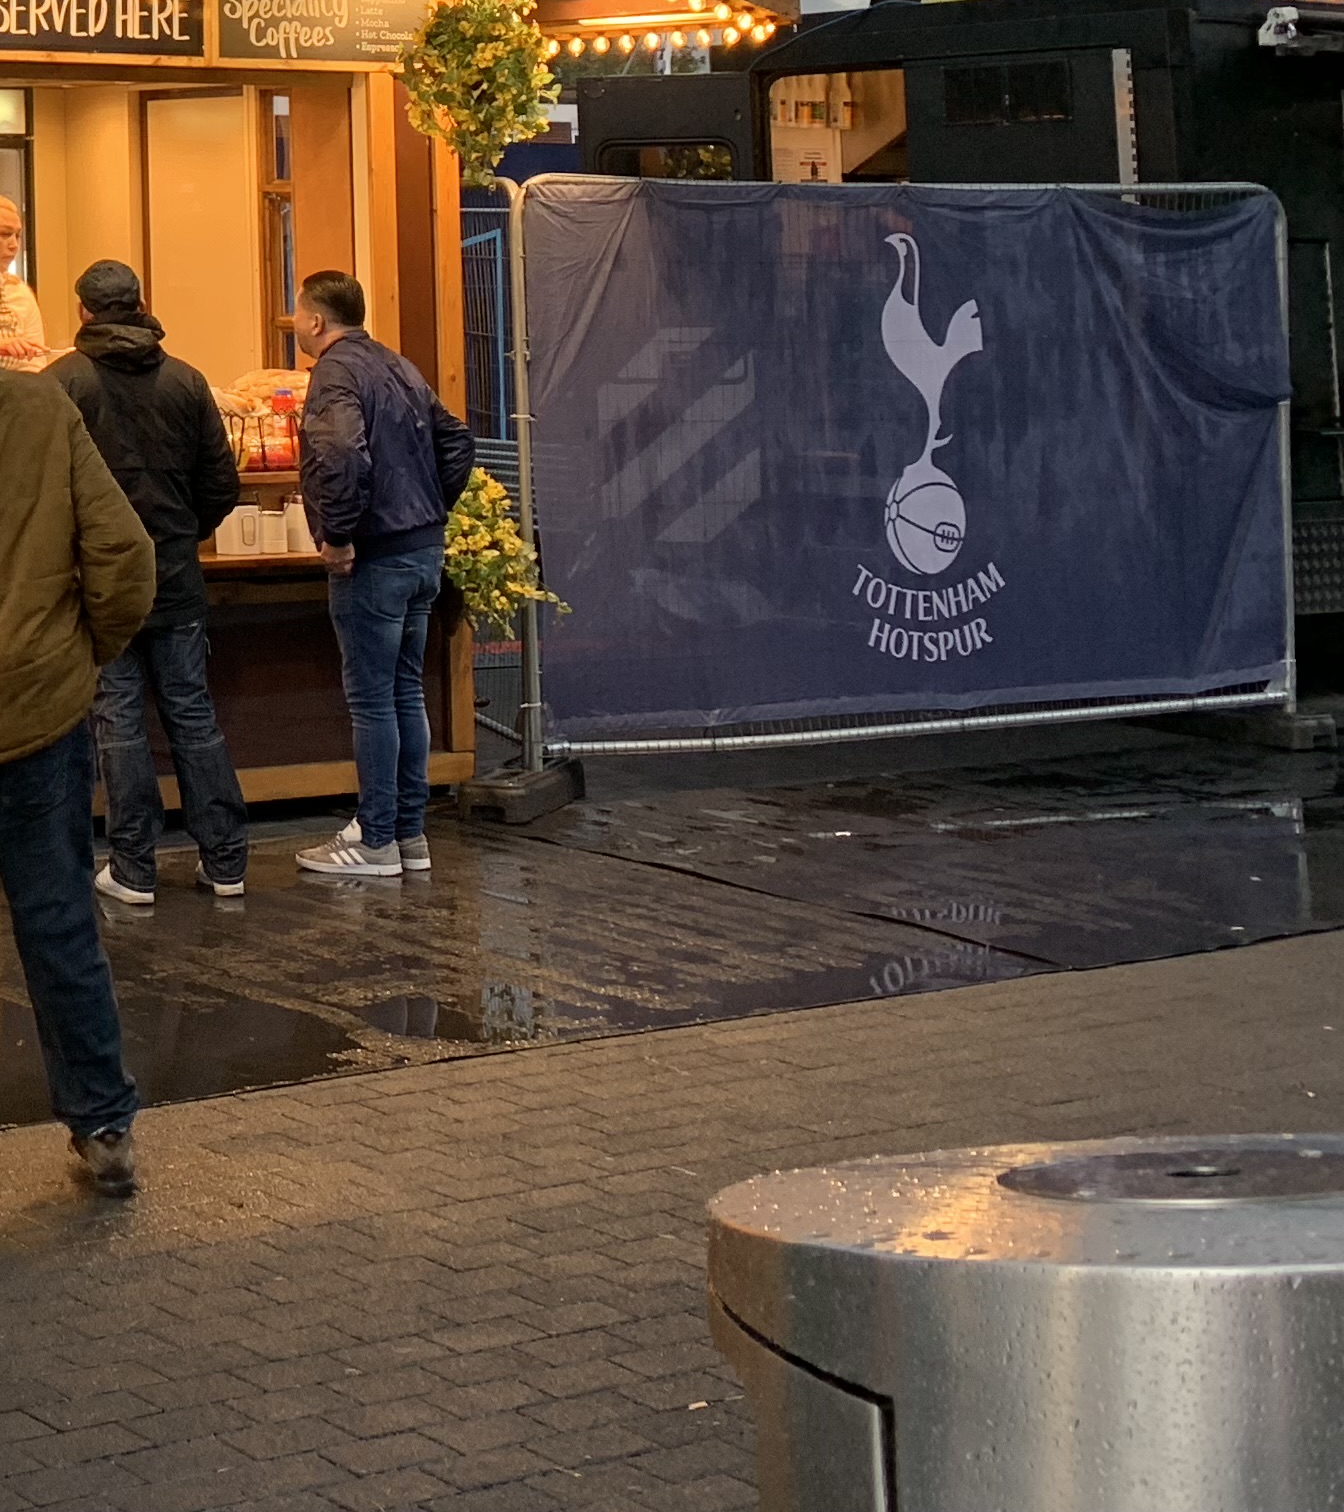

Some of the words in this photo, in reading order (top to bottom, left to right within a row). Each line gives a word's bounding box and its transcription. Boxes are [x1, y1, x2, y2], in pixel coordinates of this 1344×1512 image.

[249, 17, 334, 59] Coffees
[360, 18, 390, 29] Mocha
[360, 29, 378, 40] Hot
[852, 562, 1006, 621] TOTTENHAM
[868, 618, 994, 662] HOTSPUR
